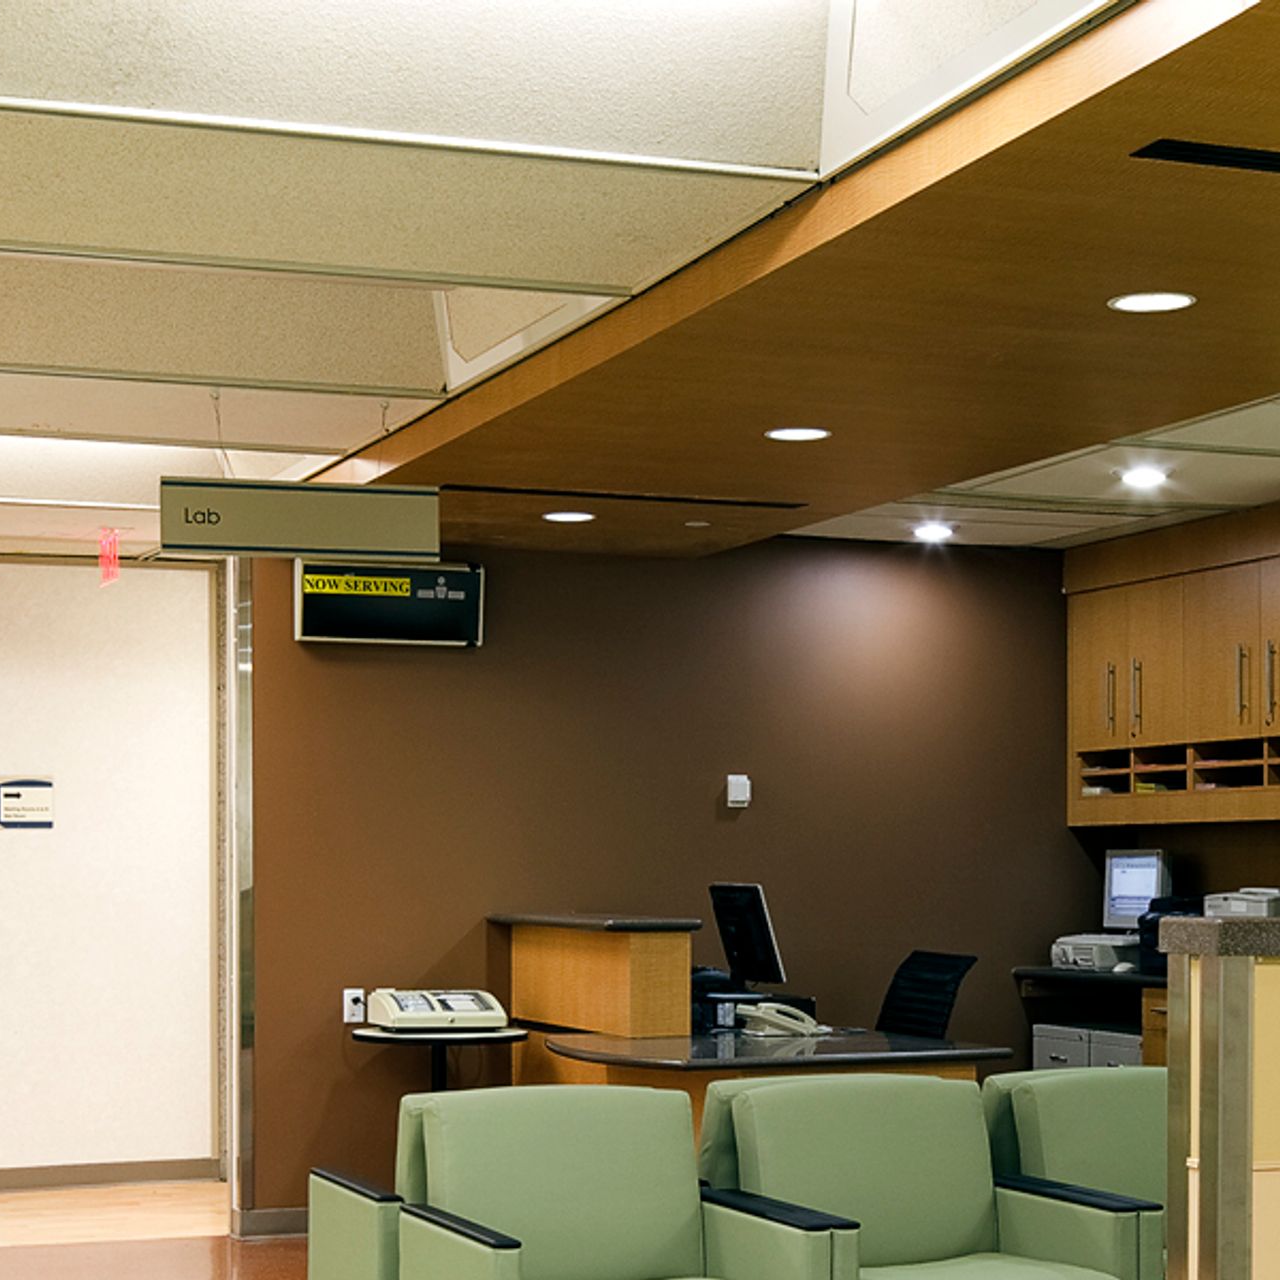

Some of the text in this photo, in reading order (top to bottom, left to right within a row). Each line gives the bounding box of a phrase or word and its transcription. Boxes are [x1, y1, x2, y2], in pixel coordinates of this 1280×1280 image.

[184, 507, 221, 525] Lab
[305, 577, 339, 591] NOW
[343, 579, 410, 594] SERVING
